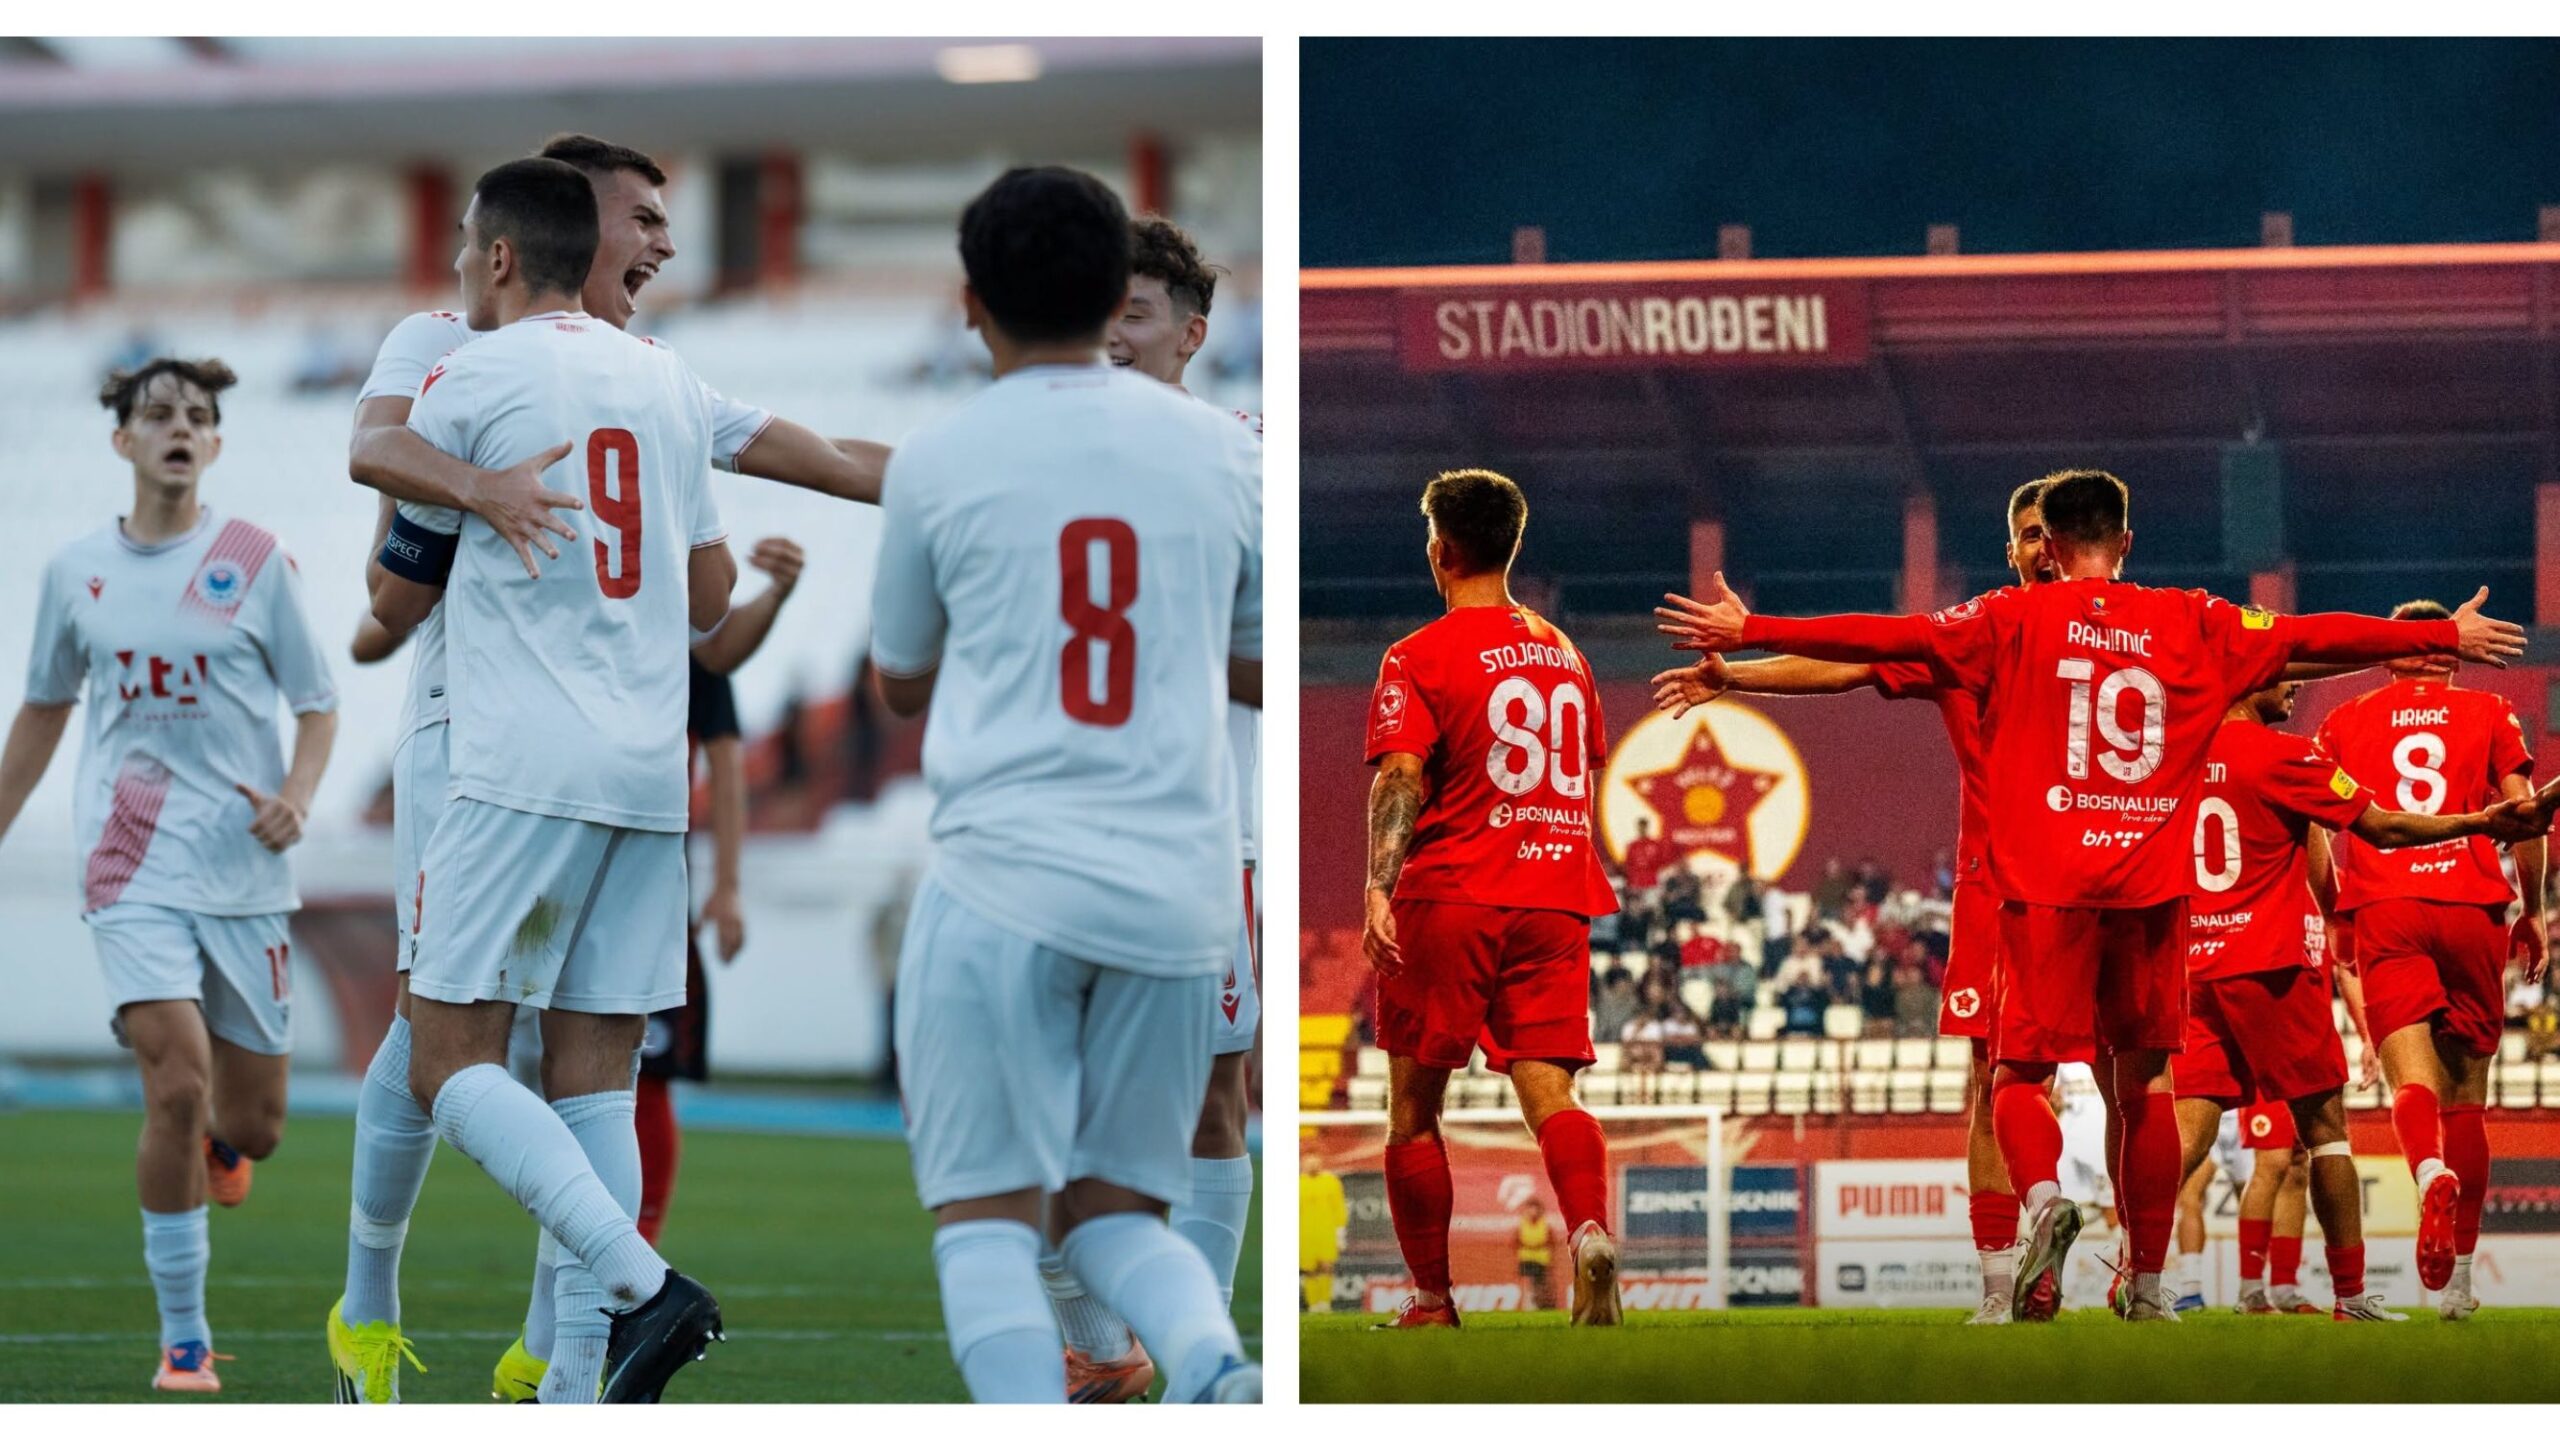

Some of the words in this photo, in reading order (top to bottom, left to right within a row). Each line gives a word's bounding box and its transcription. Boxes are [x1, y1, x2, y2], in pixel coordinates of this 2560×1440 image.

[587, 428, 641, 600] 9
[387, 534, 422, 559] SPECT
[1058, 517, 1139, 729] 8
[2068, 620, 2152, 657] RAHIMIĆ
[1487, 676, 1588, 799] 80
[2056, 657, 2168, 784] 19
[2077, 793, 2179, 813] BOSNALIJEK
[2392, 731, 2447, 816] 8
[1515, 806, 1586, 826] BOSNALIJ
[2193, 797, 2242, 892] 0
[2190, 911, 2253, 928] SNALIJEK
[1839, 1184, 1946, 1217] PUMA
